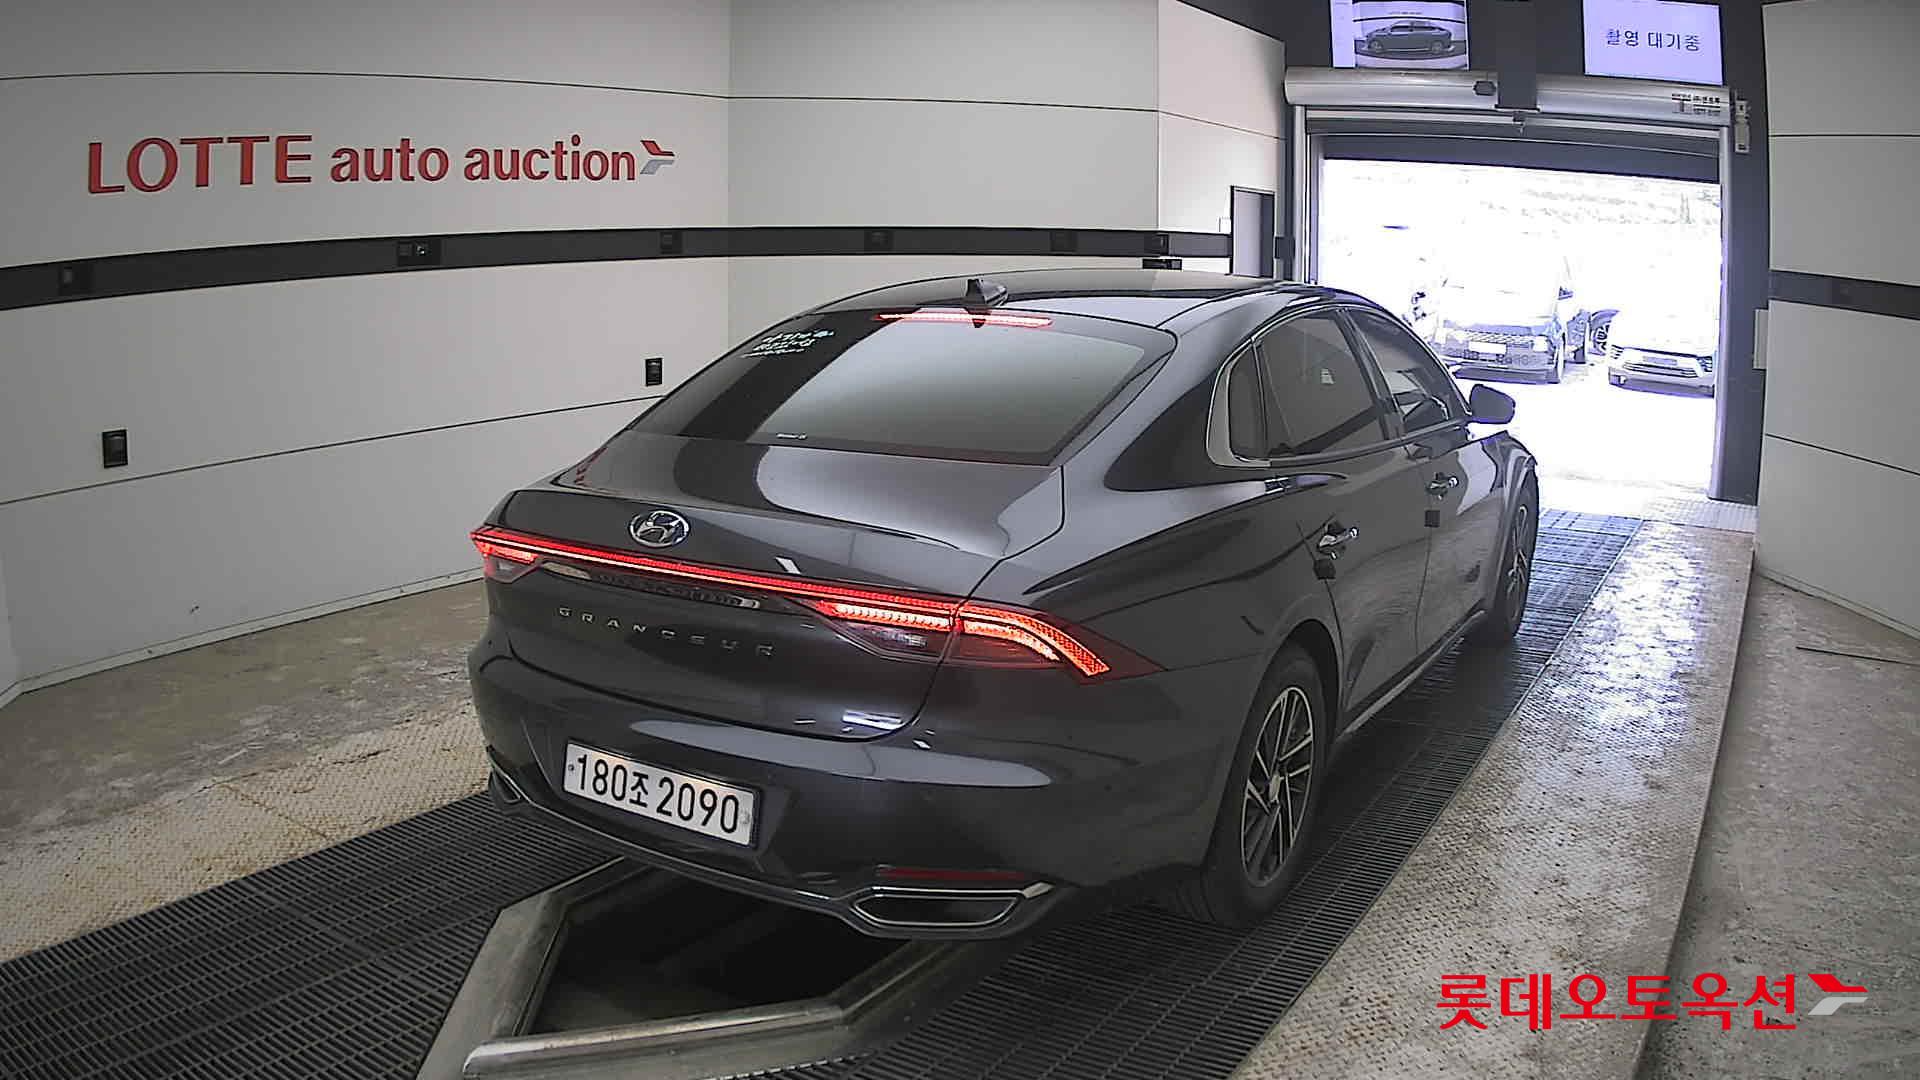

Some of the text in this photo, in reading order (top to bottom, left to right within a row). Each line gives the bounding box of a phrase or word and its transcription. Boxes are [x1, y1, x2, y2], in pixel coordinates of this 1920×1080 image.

[1647, 32, 1700, 51] 대기중
[88, 134, 636, 194] LOTTE auto auction
